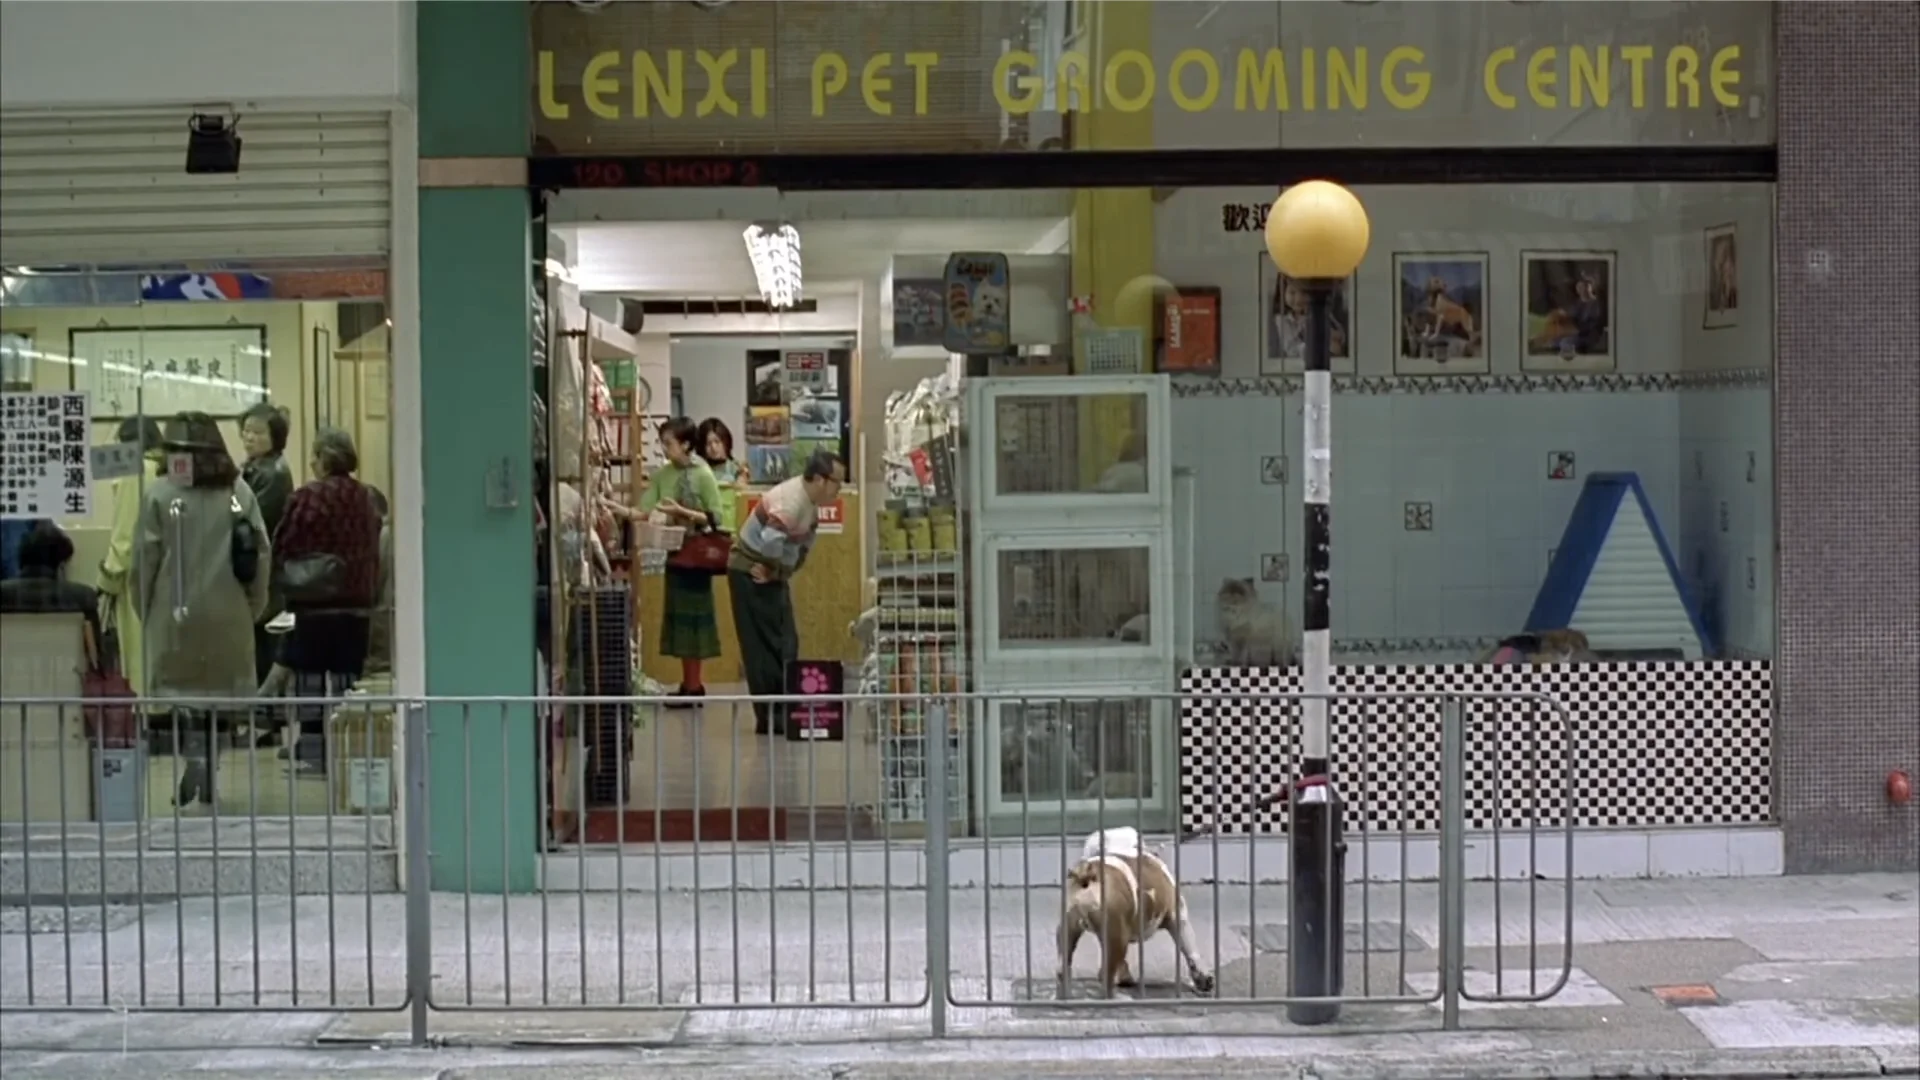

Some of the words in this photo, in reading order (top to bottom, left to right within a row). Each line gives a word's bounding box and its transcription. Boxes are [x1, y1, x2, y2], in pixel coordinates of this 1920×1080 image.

[538, 48, 769, 119] LENXI
[811, 52, 938, 116] PET
[992, 46, 1431, 114] GROOMING
[1484, 45, 1740, 108] CENTRE
[643, 162, 734, 184] SHOP
[740, 161, 760, 184] 2
[63, 395, 86, 512] 西醫陳源生
